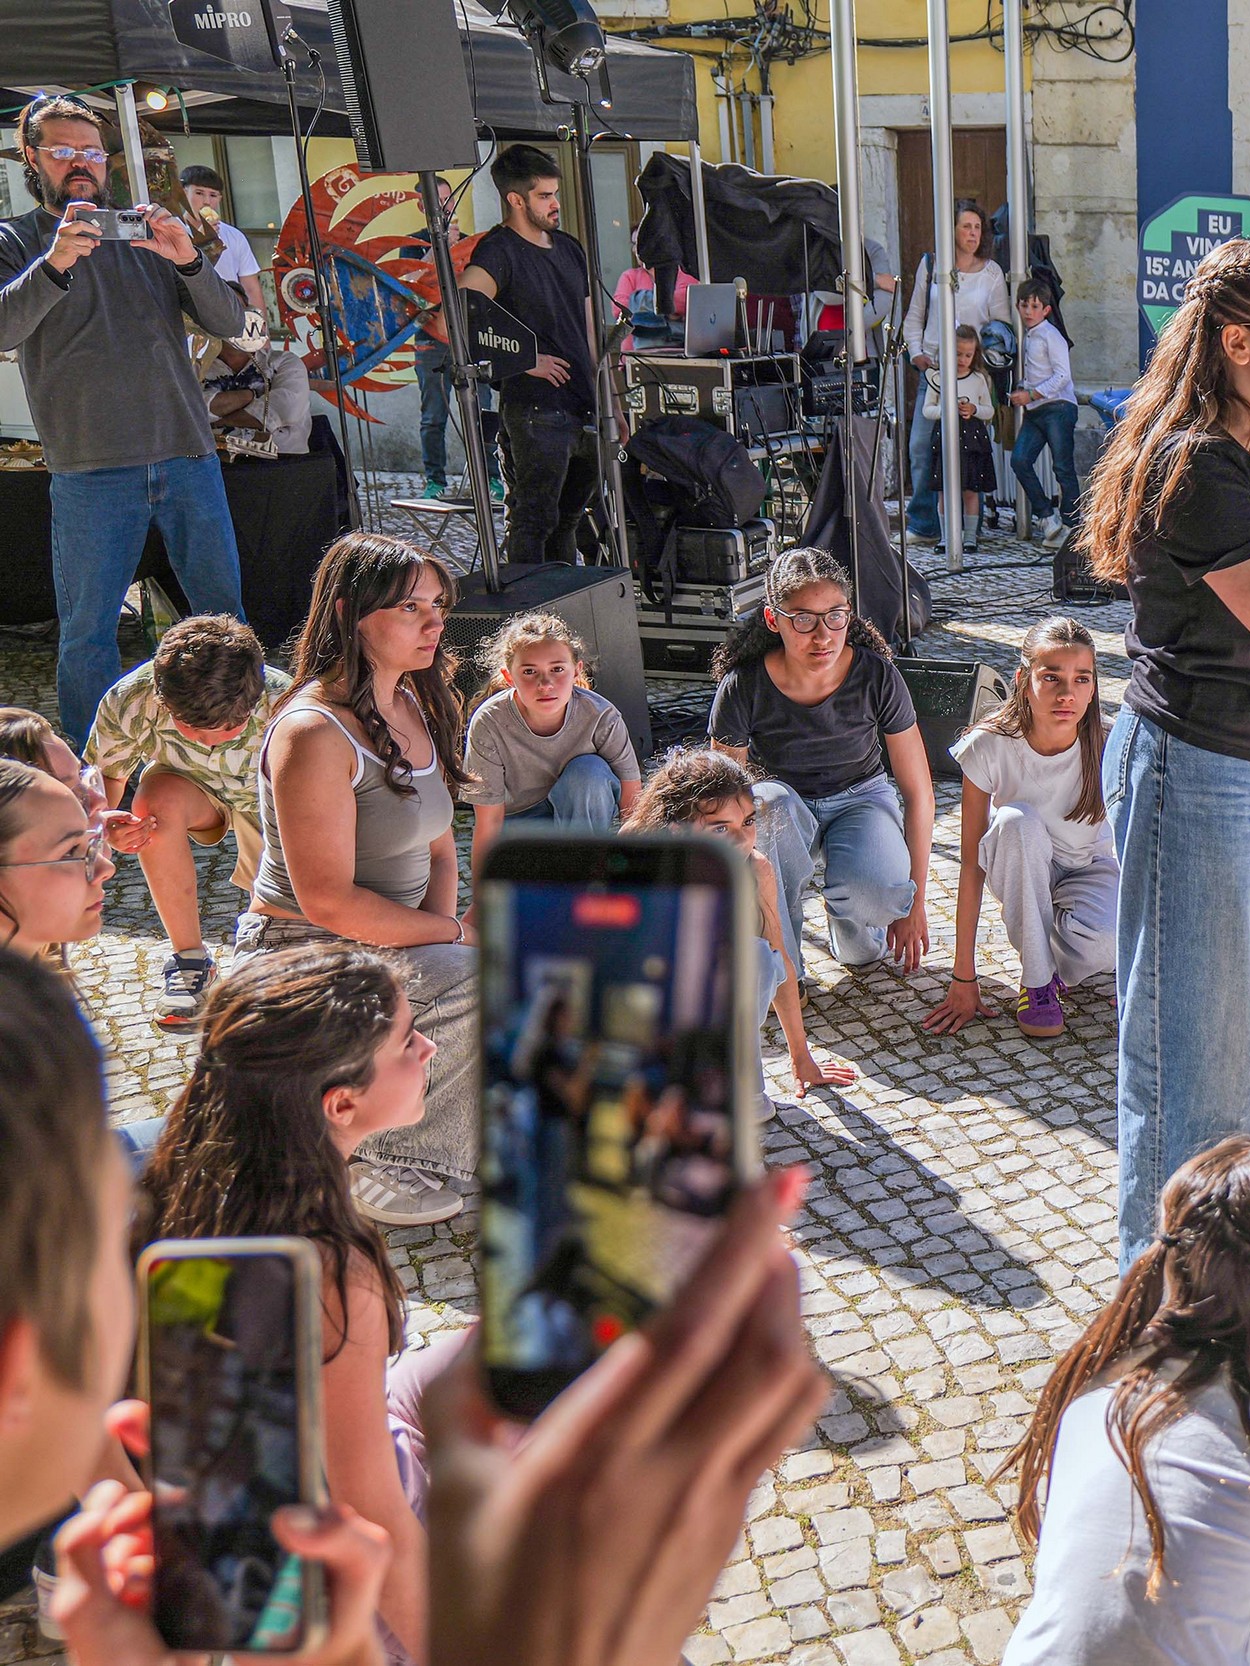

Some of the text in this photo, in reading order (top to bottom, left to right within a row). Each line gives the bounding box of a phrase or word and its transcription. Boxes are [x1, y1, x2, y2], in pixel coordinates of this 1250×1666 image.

[1208, 214, 1232, 234] EU
[1172, 259, 1197, 278] AN
[1143, 280, 1184, 301] DA C
[478, 326, 520, 353] MIPRO
